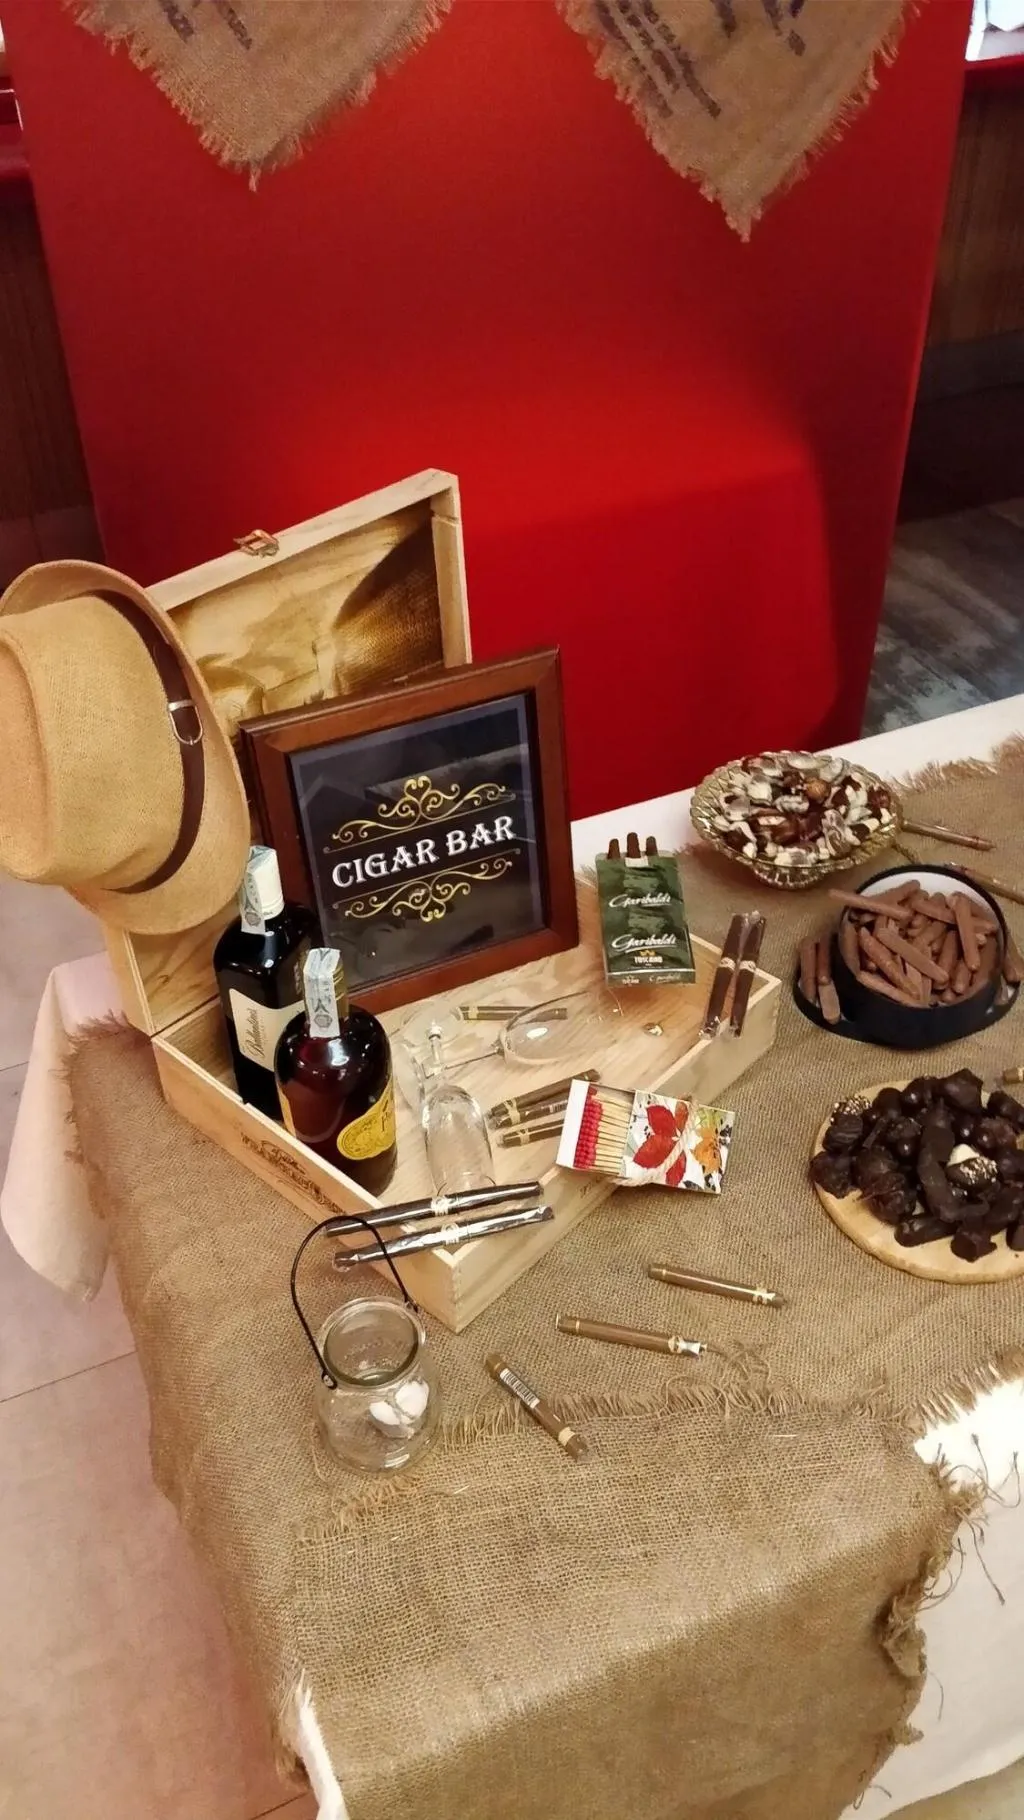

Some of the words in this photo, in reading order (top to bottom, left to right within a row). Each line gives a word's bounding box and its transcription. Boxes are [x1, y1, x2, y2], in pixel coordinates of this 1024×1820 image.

[332, 838, 439, 888] CIGAR
[446, 815, 516, 857] BAR
[611, 933, 677, 952] Garibaldi
